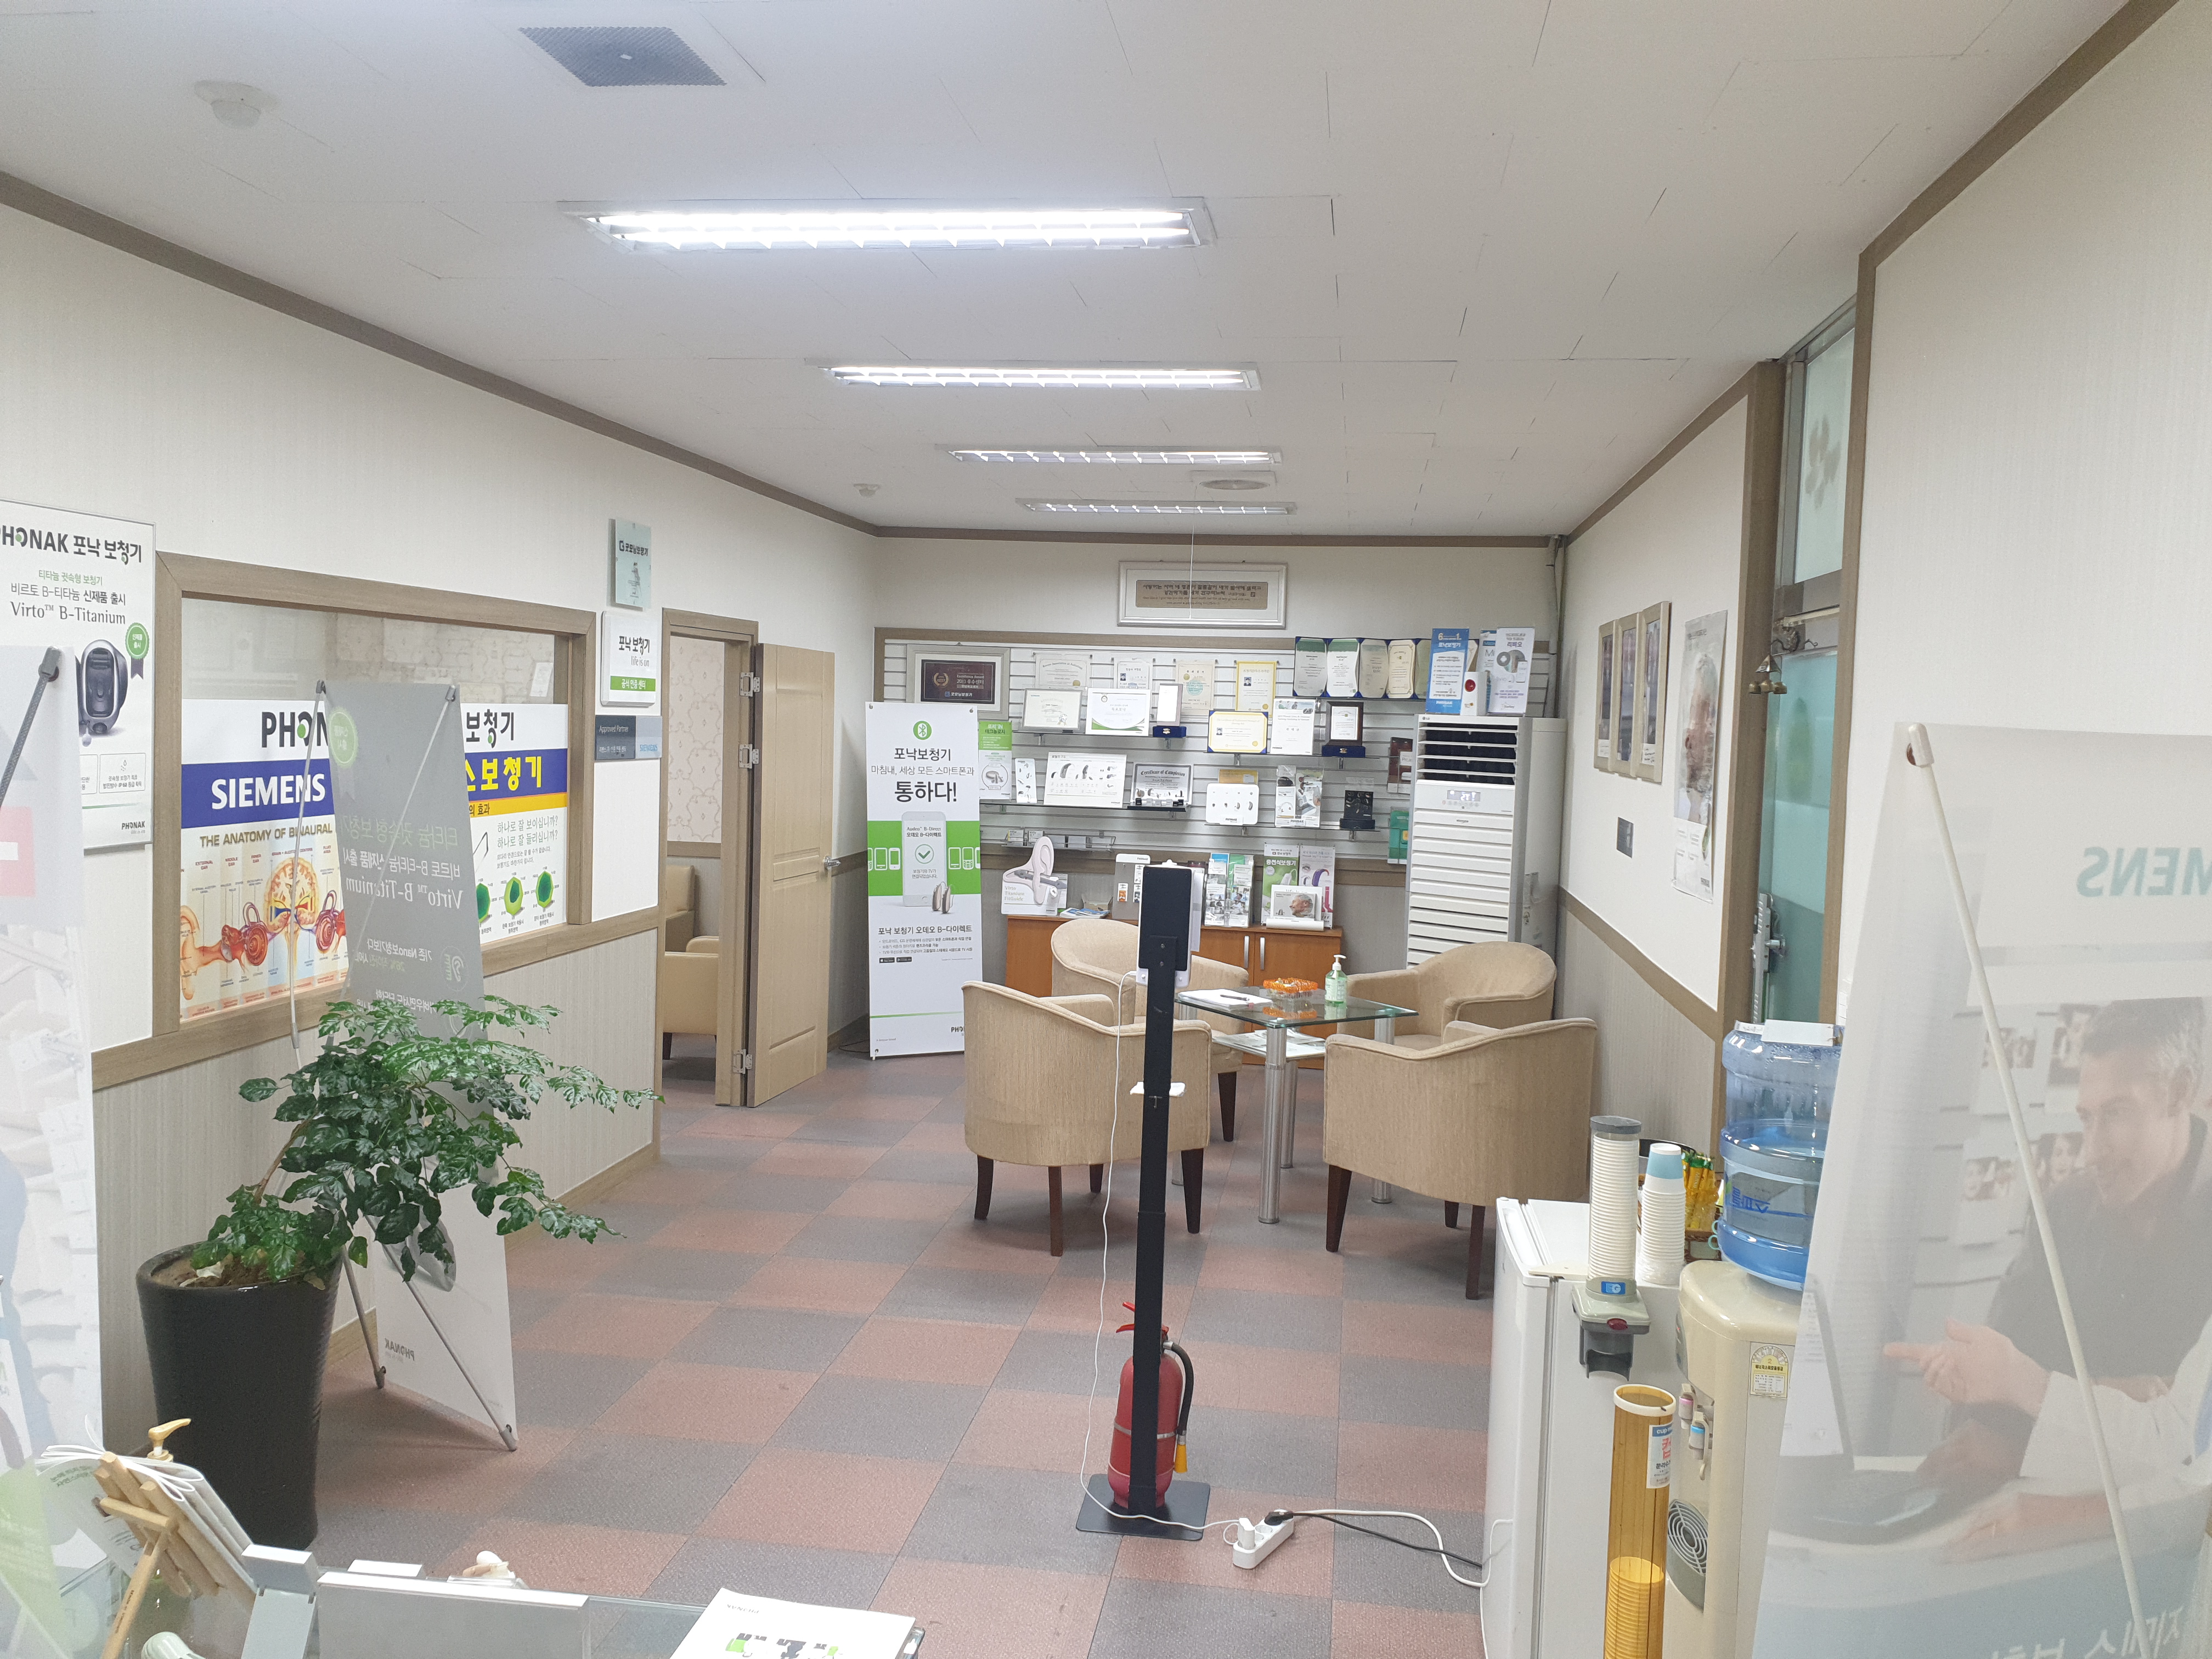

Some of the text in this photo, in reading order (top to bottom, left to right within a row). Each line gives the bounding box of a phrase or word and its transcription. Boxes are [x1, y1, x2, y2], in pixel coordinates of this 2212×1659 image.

[0, 524, 142, 565] HONAK 포낙 보청기
[38, 570, 103, 586] 티타늄 귓속형 보청기
[11, 583, 126, 606] 비르토 B-티타늄 신제품 출시
[59, 605, 126, 624] B-Titanium
[619, 635, 650, 655] 포낙 보청기
[631, 656, 639, 666] life
[640, 657, 643, 666] is
[621, 679, 629, 689] 공식
[638, 680, 646, 690] 센터
[466, 709, 514, 748] 보청기
[599, 725, 616, 734] Approved
[894, 748, 951, 761] 포낙보청기
[871, 765, 974, 776] 마침내, 세상 모든 스마트폰과
[211, 774, 325, 810] SIEMENS
[895, 781, 957, 802] 통하다!
[478, 803, 490, 815] 효과
[121, 821, 145, 830] PHONAK
[498, 815, 558, 833] 하나로 잘 보이십니까?
[200, 823, 332, 848] THE ANATOMY OF BINAURAL
[498, 830, 558, 849] 하나로 잘 들리십니까?
[894, 926, 913, 934] 보청기
[938, 925, 973, 933] B-다이렉트
